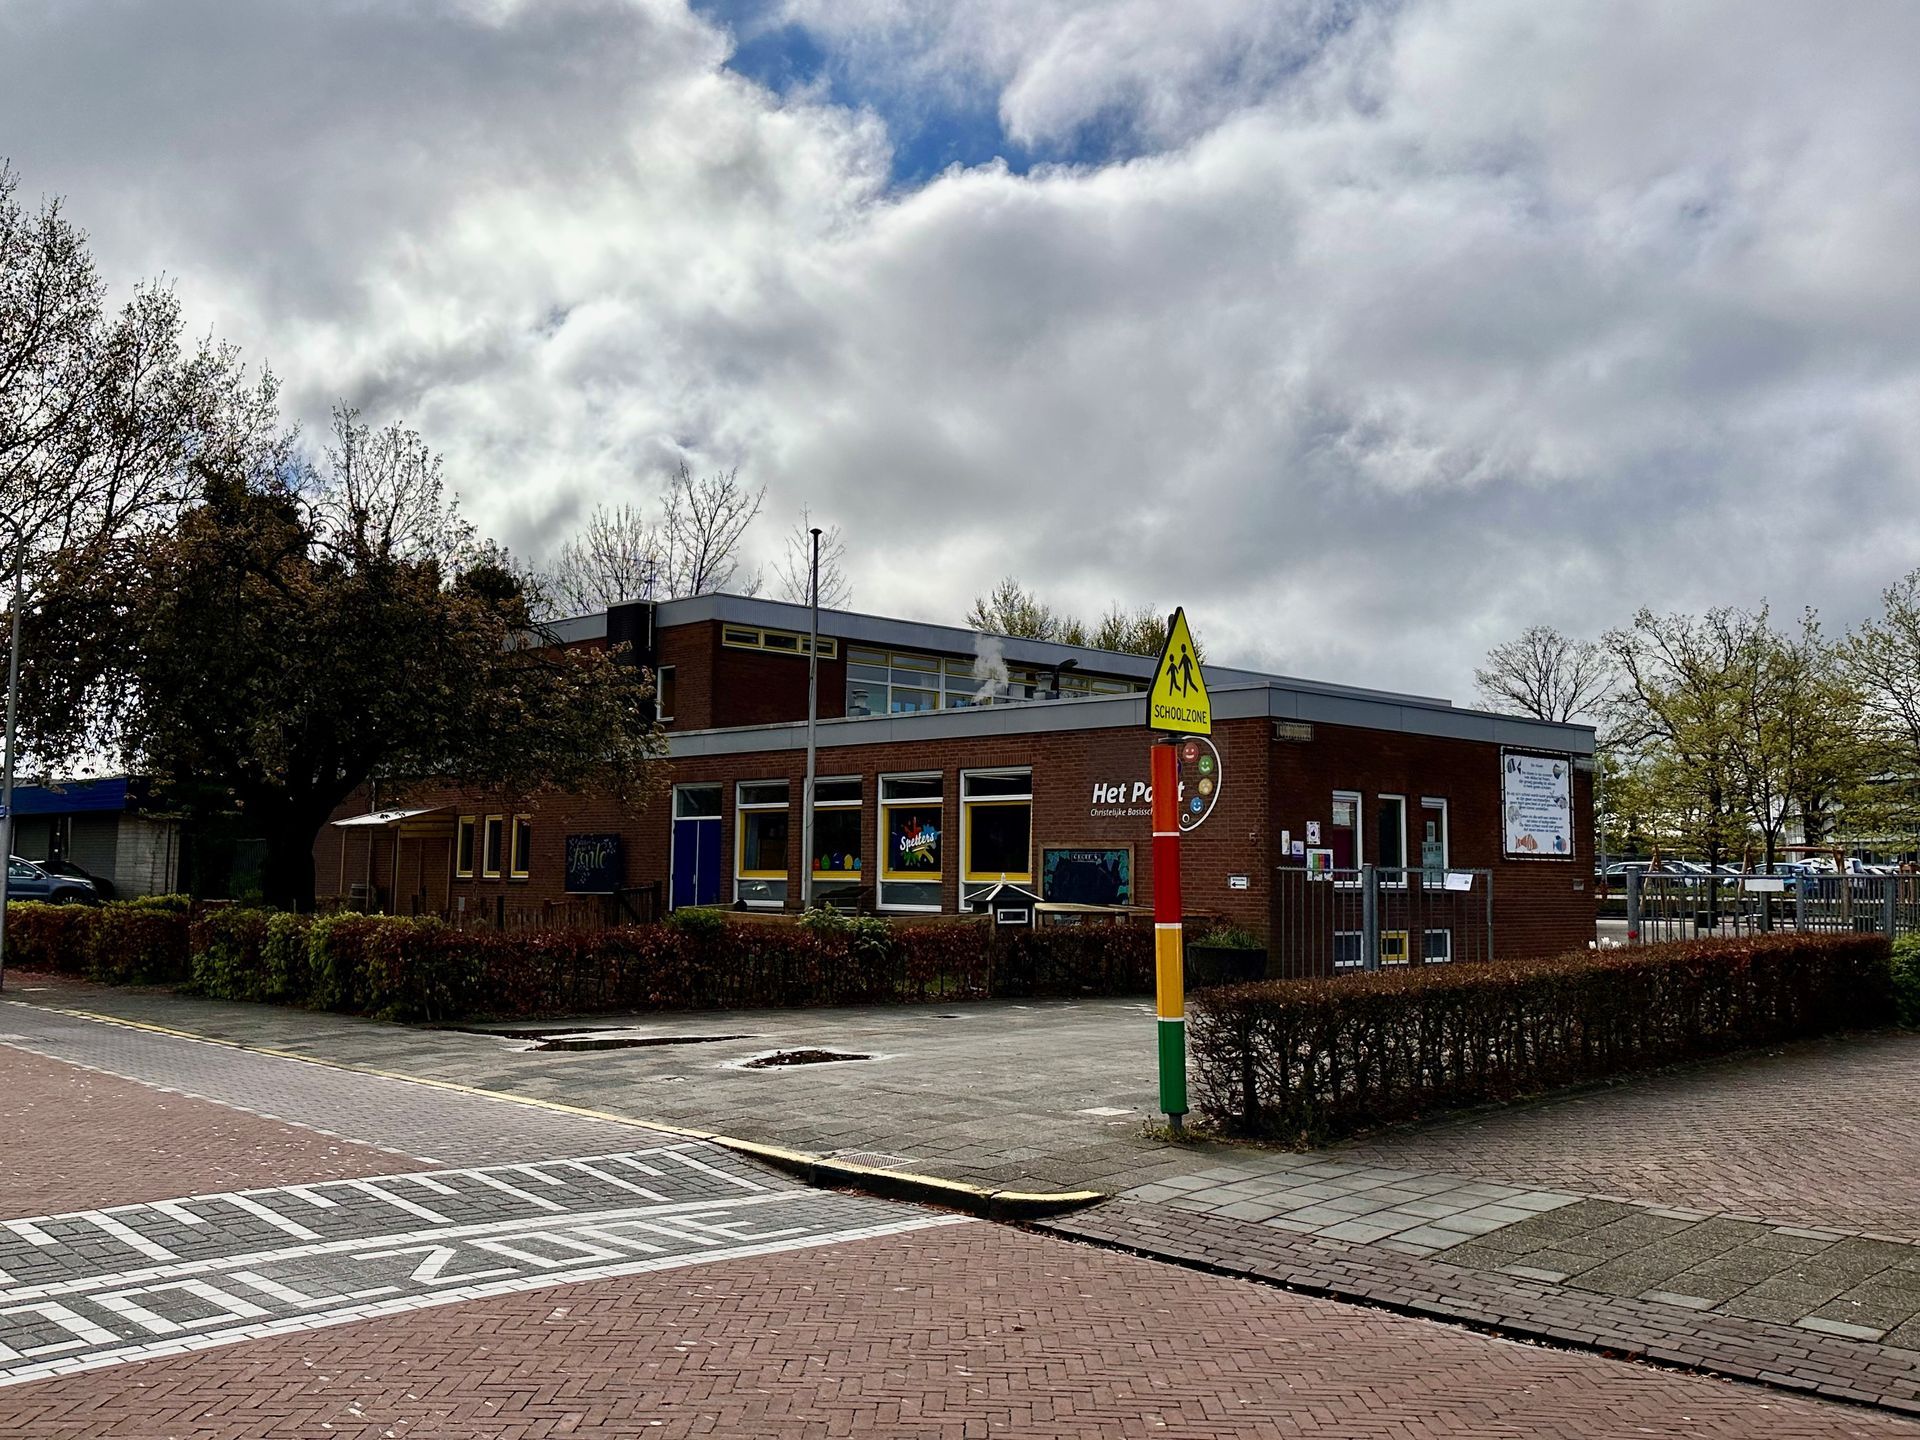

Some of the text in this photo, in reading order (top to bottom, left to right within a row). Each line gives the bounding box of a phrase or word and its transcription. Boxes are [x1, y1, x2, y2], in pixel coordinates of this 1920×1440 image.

[1154, 704, 1208, 725] SCHOOLZONE
[1092, 781, 1185, 804] Het Pat
[1090, 808, 1126, 818] Christelijke
[899, 832, 935, 853] Spetters
[1248, 832, 1257, 845] 5
[350, 1211, 812, 1286] ZONE
